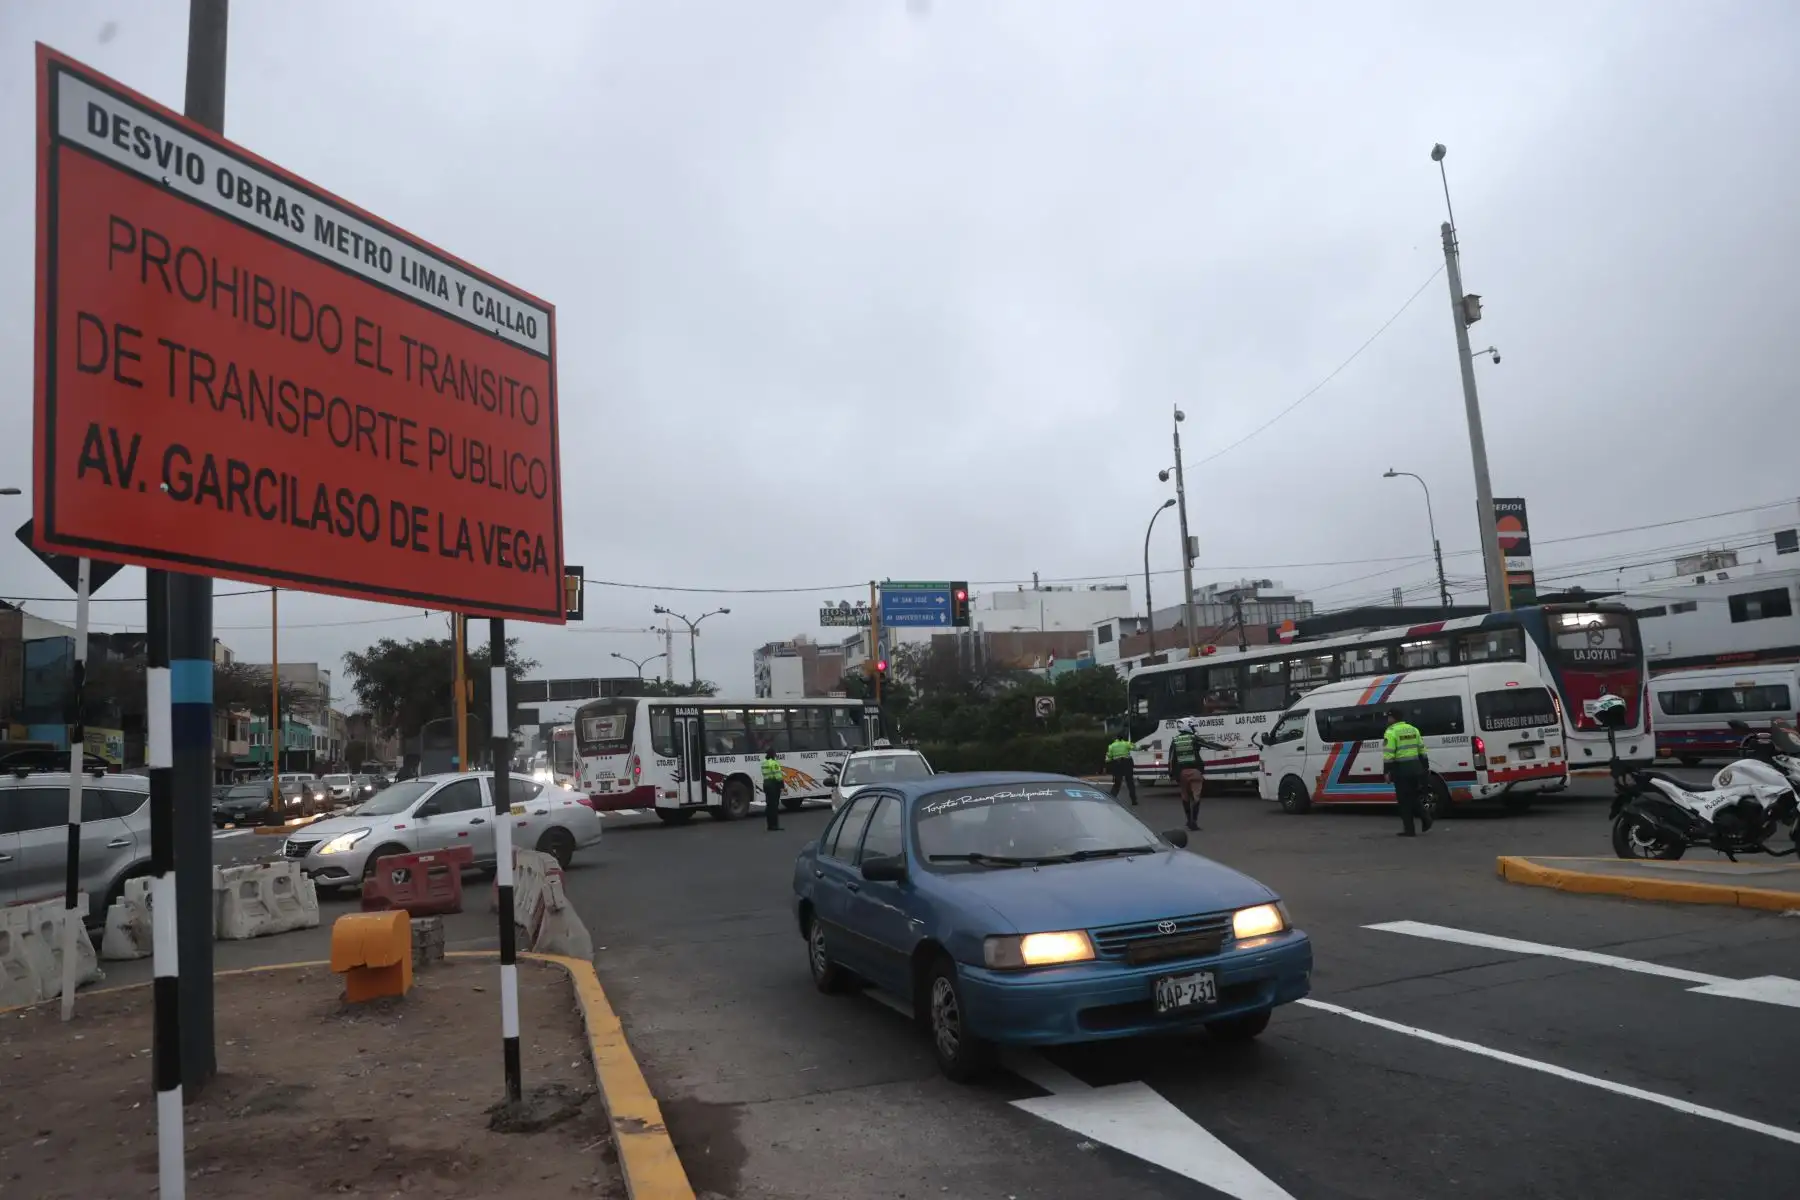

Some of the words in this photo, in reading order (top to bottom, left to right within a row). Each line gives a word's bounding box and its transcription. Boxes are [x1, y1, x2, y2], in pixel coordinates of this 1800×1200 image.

[87, 100, 205, 186] DESVIO
[216, 166, 305, 234] OBRAS
[314, 213, 393, 274] METRO
[400, 255, 450, 301] LIMA
[456, 282, 467, 308] Y
[472, 289, 538, 341] CALLAO
[108, 214, 343, 354] PROHIBIDO
[354, 317, 394, 376] EL
[400, 333, 540, 427] TRANSITO
[75, 310, 144, 389] DE
[158, 337, 419, 468] TRANSPORTE
[429, 427, 549, 501] PUBLICO
[76, 422, 147, 494] AV.
[162, 443, 381, 543] GARCILASO
[389, 499, 430, 554] DE
[438, 511, 475, 562] LA
[480, 525, 550, 577] VEGA
[1574, 649, 1585, 660] LA
[1586, 649, 1610, 660] JOYA
[675, 707, 699, 716] BAJADA
[1235, 715, 1246, 725] LAS
[1246, 714, 1267, 724] FLORES
[1520, 715, 1528, 726] DE
[707, 756, 719, 765] PTE.
[719, 756, 736, 764] NUEVO
[744, 754, 761, 762] BRASIL
[800, 752, 819, 760] FAUCETT
[921, 799, 958, 814] Toyota
[957, 795, 995, 805] Racing
[993, 788, 1059, 801] Development
[1157, 979, 1216, 1010] AAP-231
